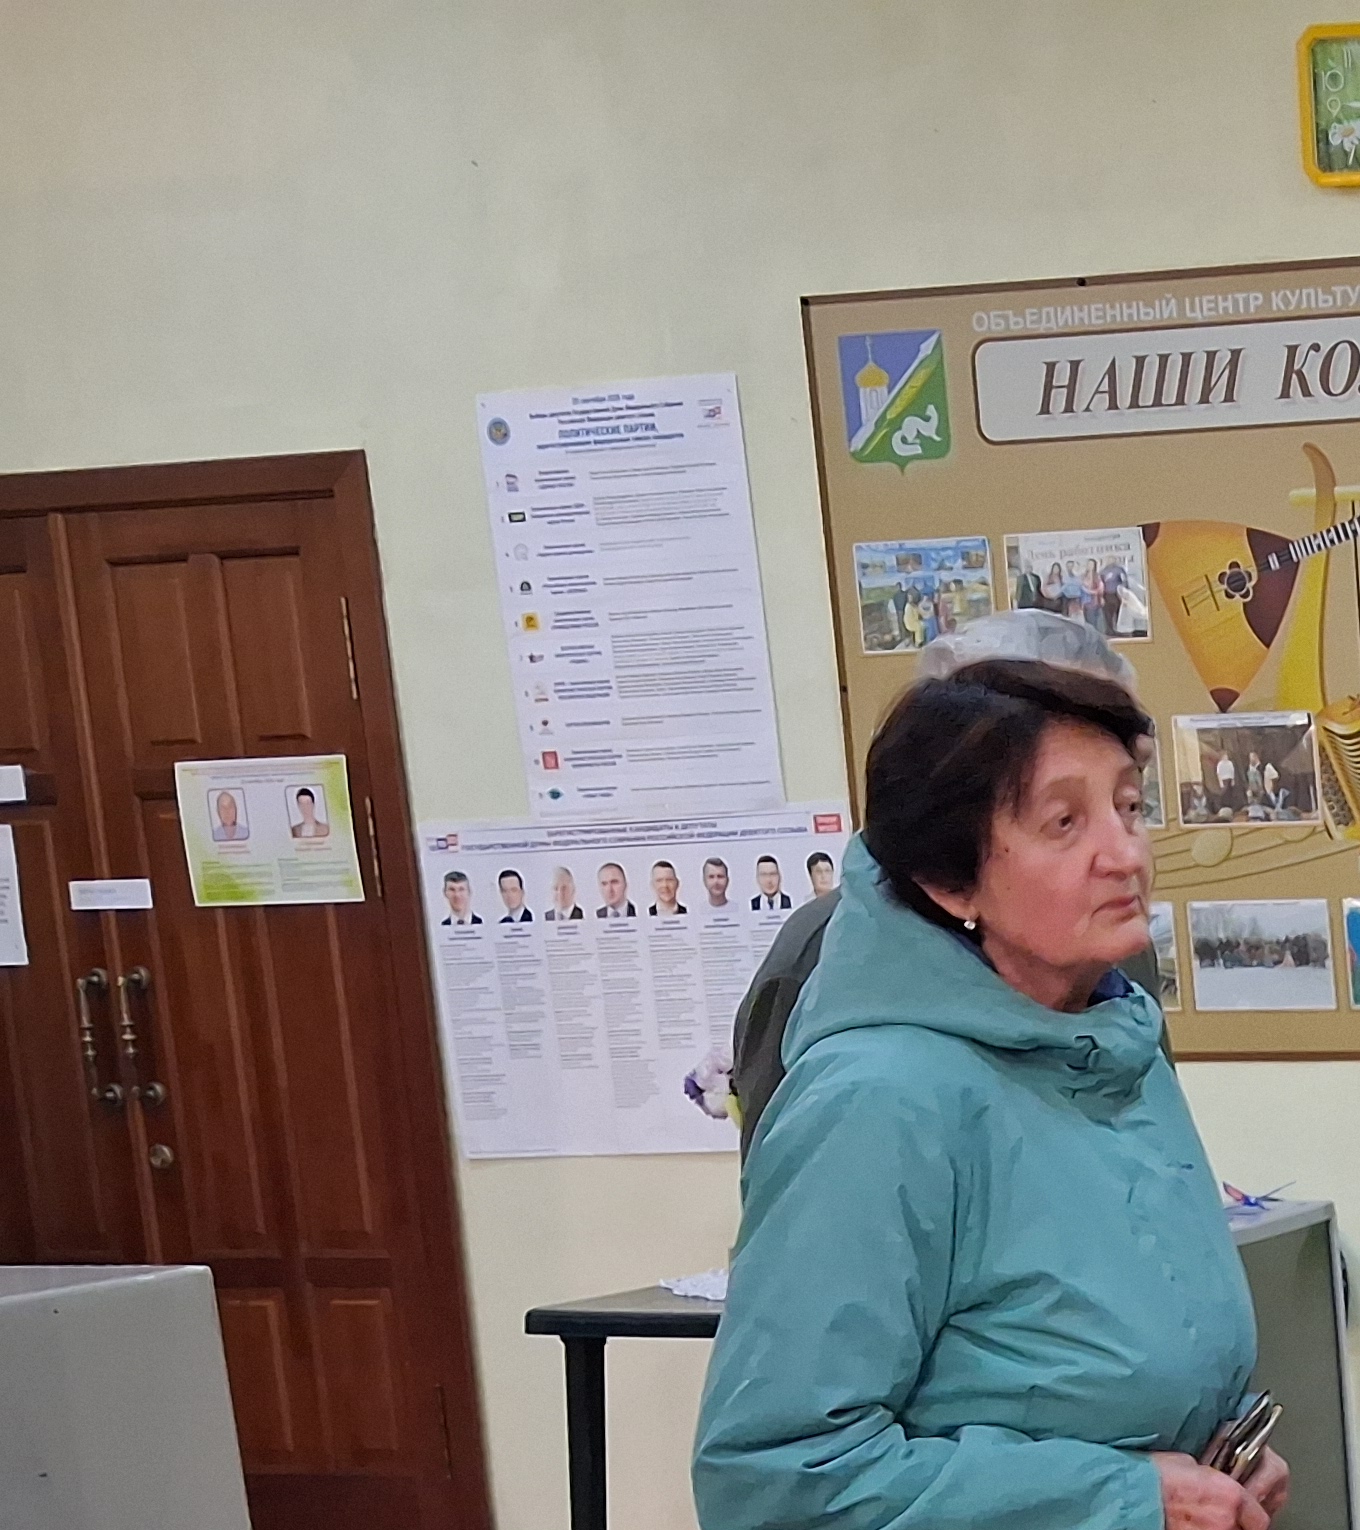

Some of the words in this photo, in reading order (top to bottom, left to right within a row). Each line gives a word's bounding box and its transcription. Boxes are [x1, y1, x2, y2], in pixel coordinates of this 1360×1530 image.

[1321, 70, 1345, 92] 10
[972, 293, 1177, 333] ОБЪЕДИНЕННЫЙ
[1185, 292, 1264, 319] ЦЕНТР
[1036, 346, 1246, 417] НАШИ
